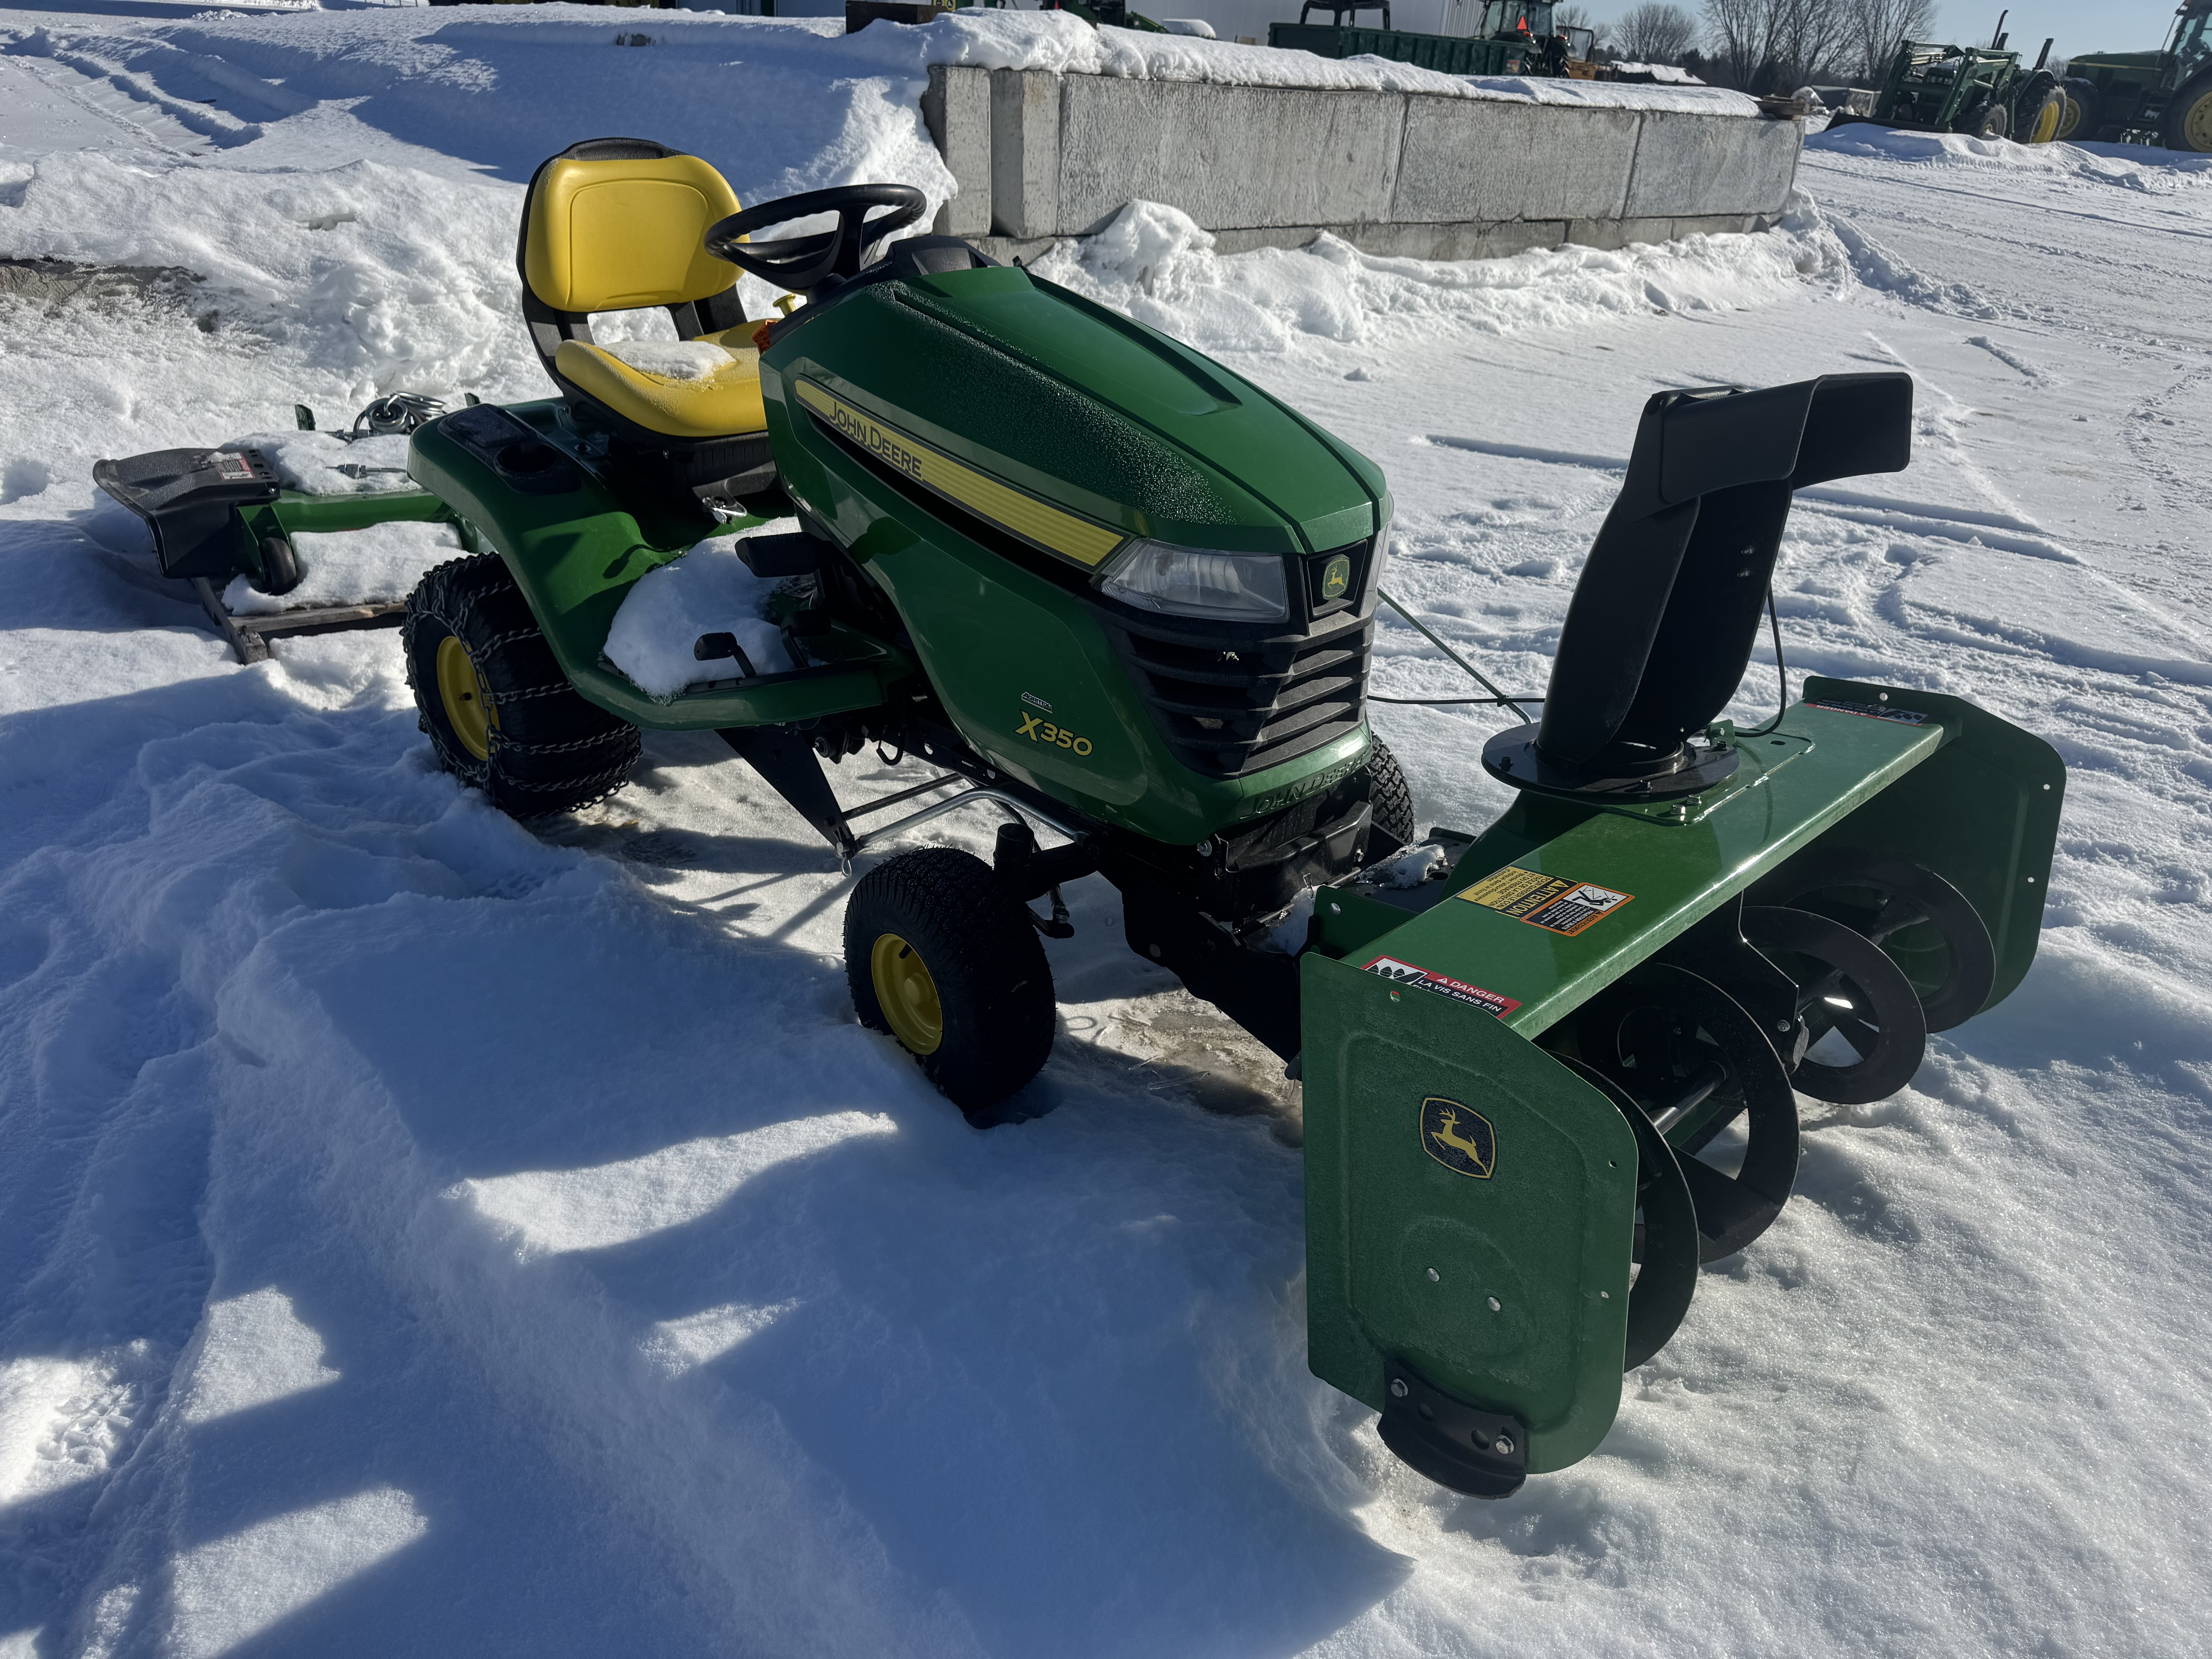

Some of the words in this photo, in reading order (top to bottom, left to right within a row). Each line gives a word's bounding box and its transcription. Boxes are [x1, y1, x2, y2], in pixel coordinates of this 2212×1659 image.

[830, 401, 867, 443] JOHN
[871, 425, 922, 478] DEERE
[1022, 692, 1051, 708] AGRITEX
[1015, 711, 1092, 756] X350
[1240, 782, 1306, 819] JOHN
[1306, 750, 1367, 795] DEERE
[1534, 877, 1551, 885] POUR
[1505, 885, 1561, 915] ATTENTION
[1418, 979, 1434, 988] LA
[1434, 984, 1451, 994] VIS
[1451, 991, 1482, 1005] SANS
[1482, 1002, 1502, 1012] FIN
[1449, 981, 1505, 1003] DANGER
